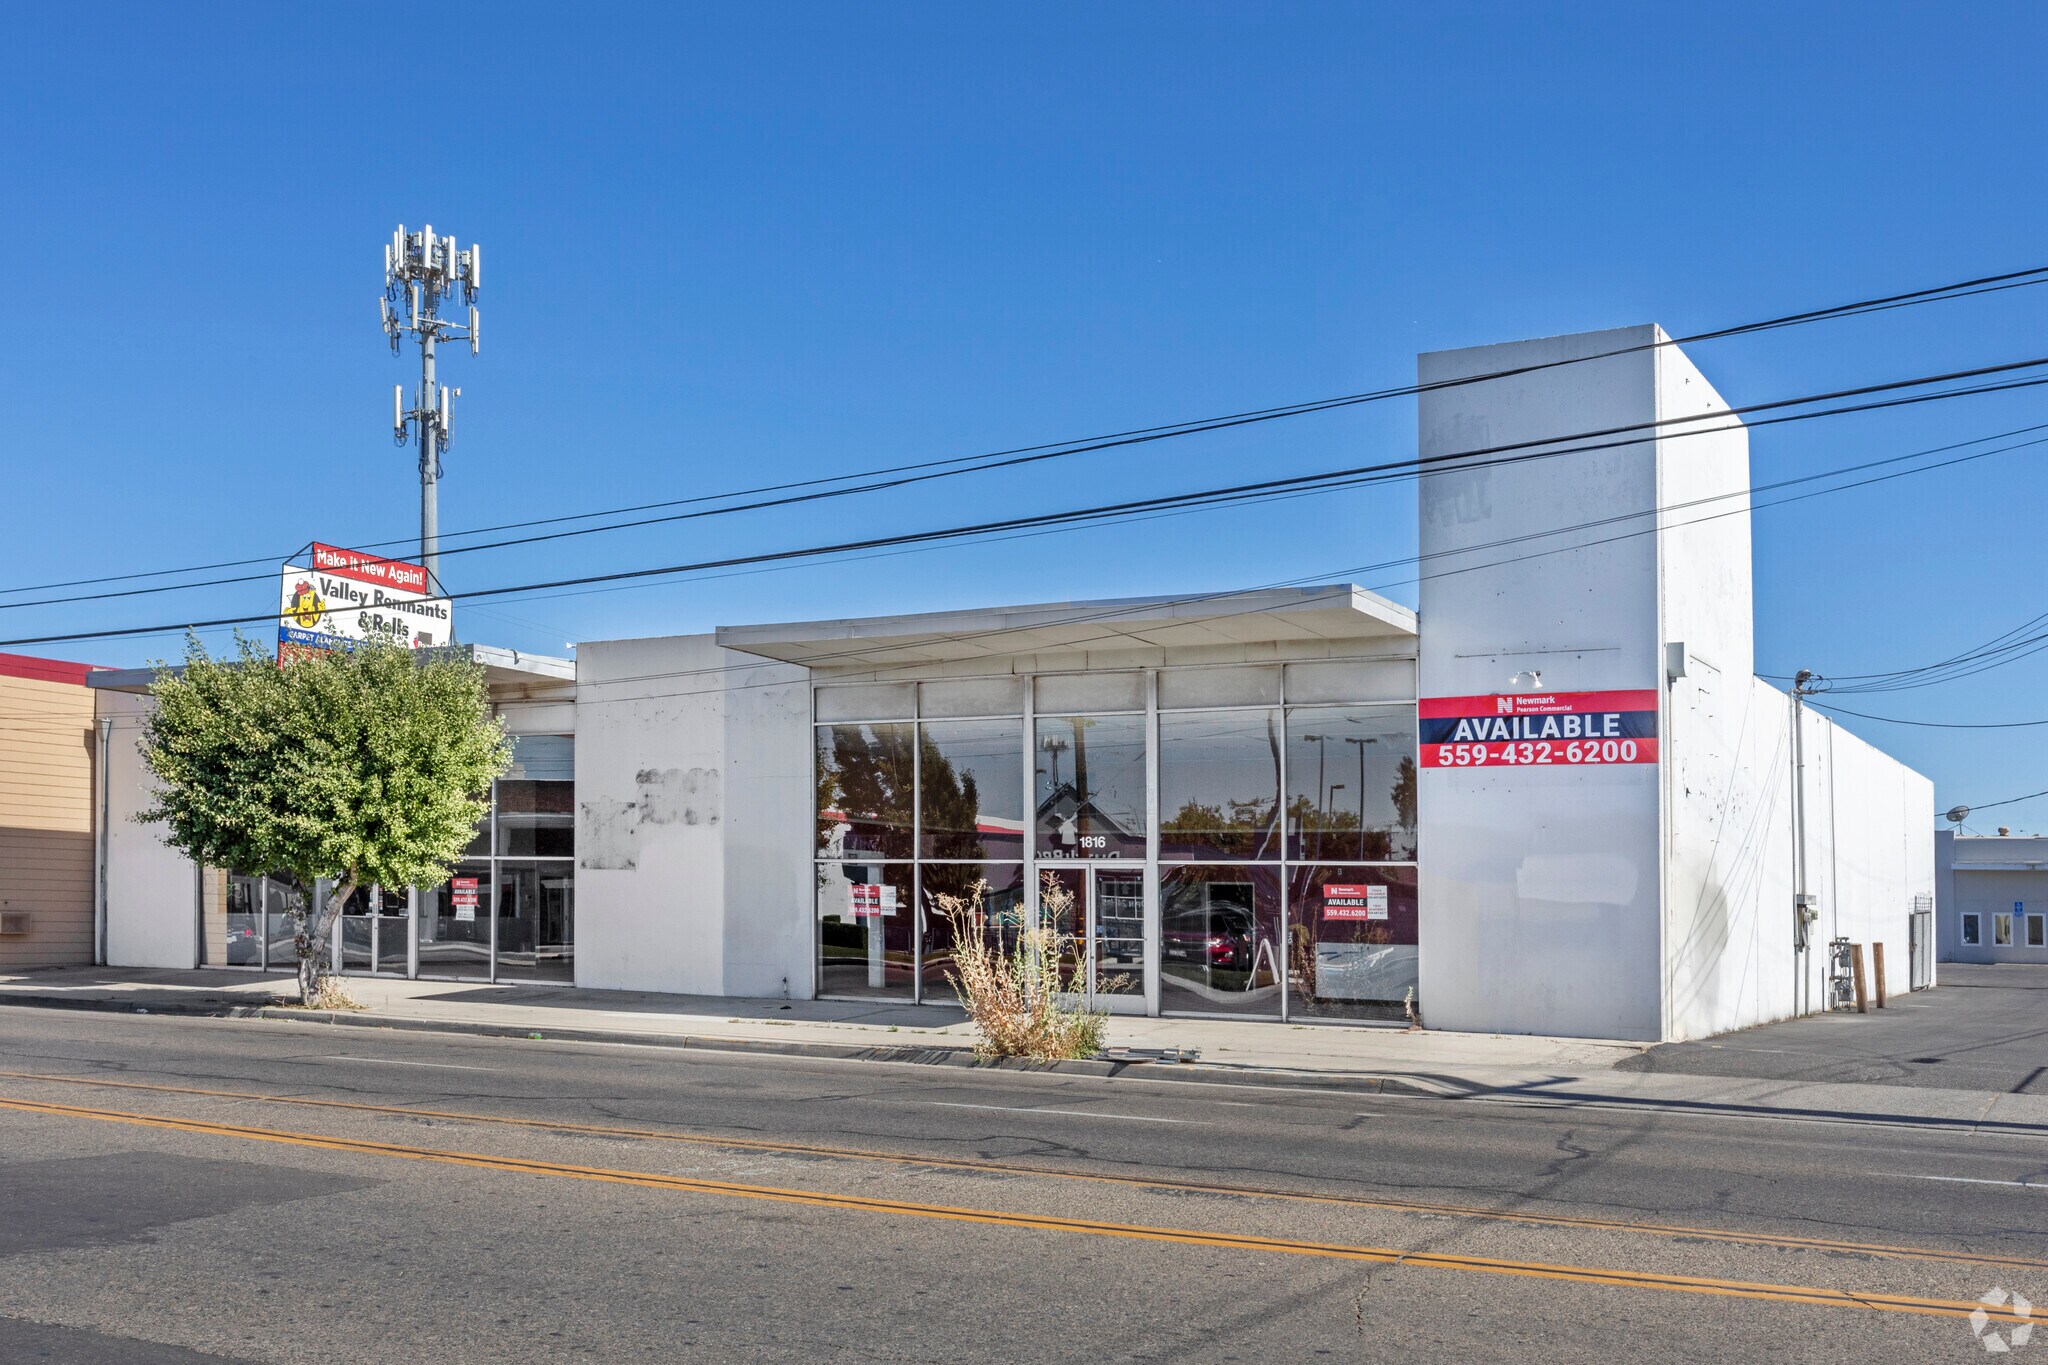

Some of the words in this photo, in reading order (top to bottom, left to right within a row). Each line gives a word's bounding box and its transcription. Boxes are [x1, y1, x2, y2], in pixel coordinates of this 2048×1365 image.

[317, 549, 347, 567] Make
[350, 556, 359, 572] it
[361, 558, 386, 577] New
[388, 565, 423, 586] Again!
[319, 577, 369, 608] Valley
[374, 588, 448, 620] Remnants
[357, 610, 369, 629] &
[373, 613, 409, 637] Rolls
[1516, 695, 1555, 705] Newmark
[1540, 704, 1572, 712] Commercial
[1454, 713, 1620, 741] AVAILABLE
[1438, 740, 1637, 766] 559-432-6200
[1079, 836, 1106, 848] 1816
[1327, 898, 1364, 906] AVAILABLE
